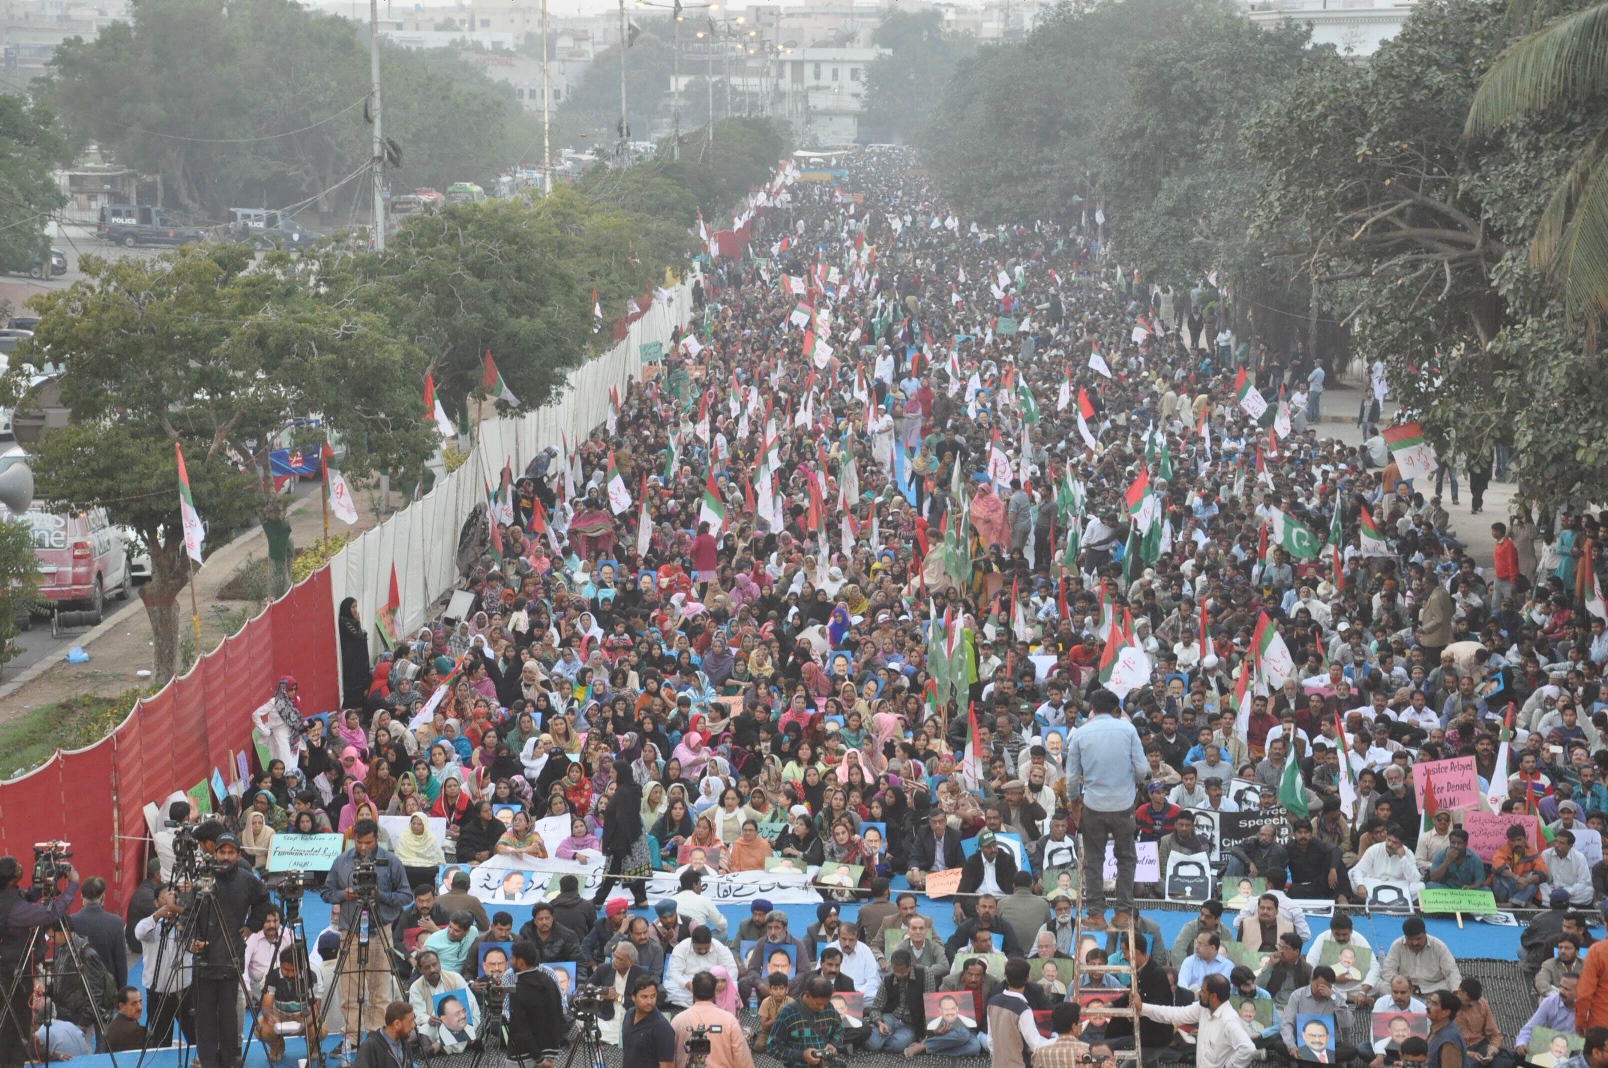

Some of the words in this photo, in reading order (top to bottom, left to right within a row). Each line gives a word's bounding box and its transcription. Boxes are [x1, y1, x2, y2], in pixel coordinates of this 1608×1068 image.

[111, 217, 136, 225] POLICE
[1239, 816, 1288, 828] Speech
[1280, 827, 1289, 835] a
